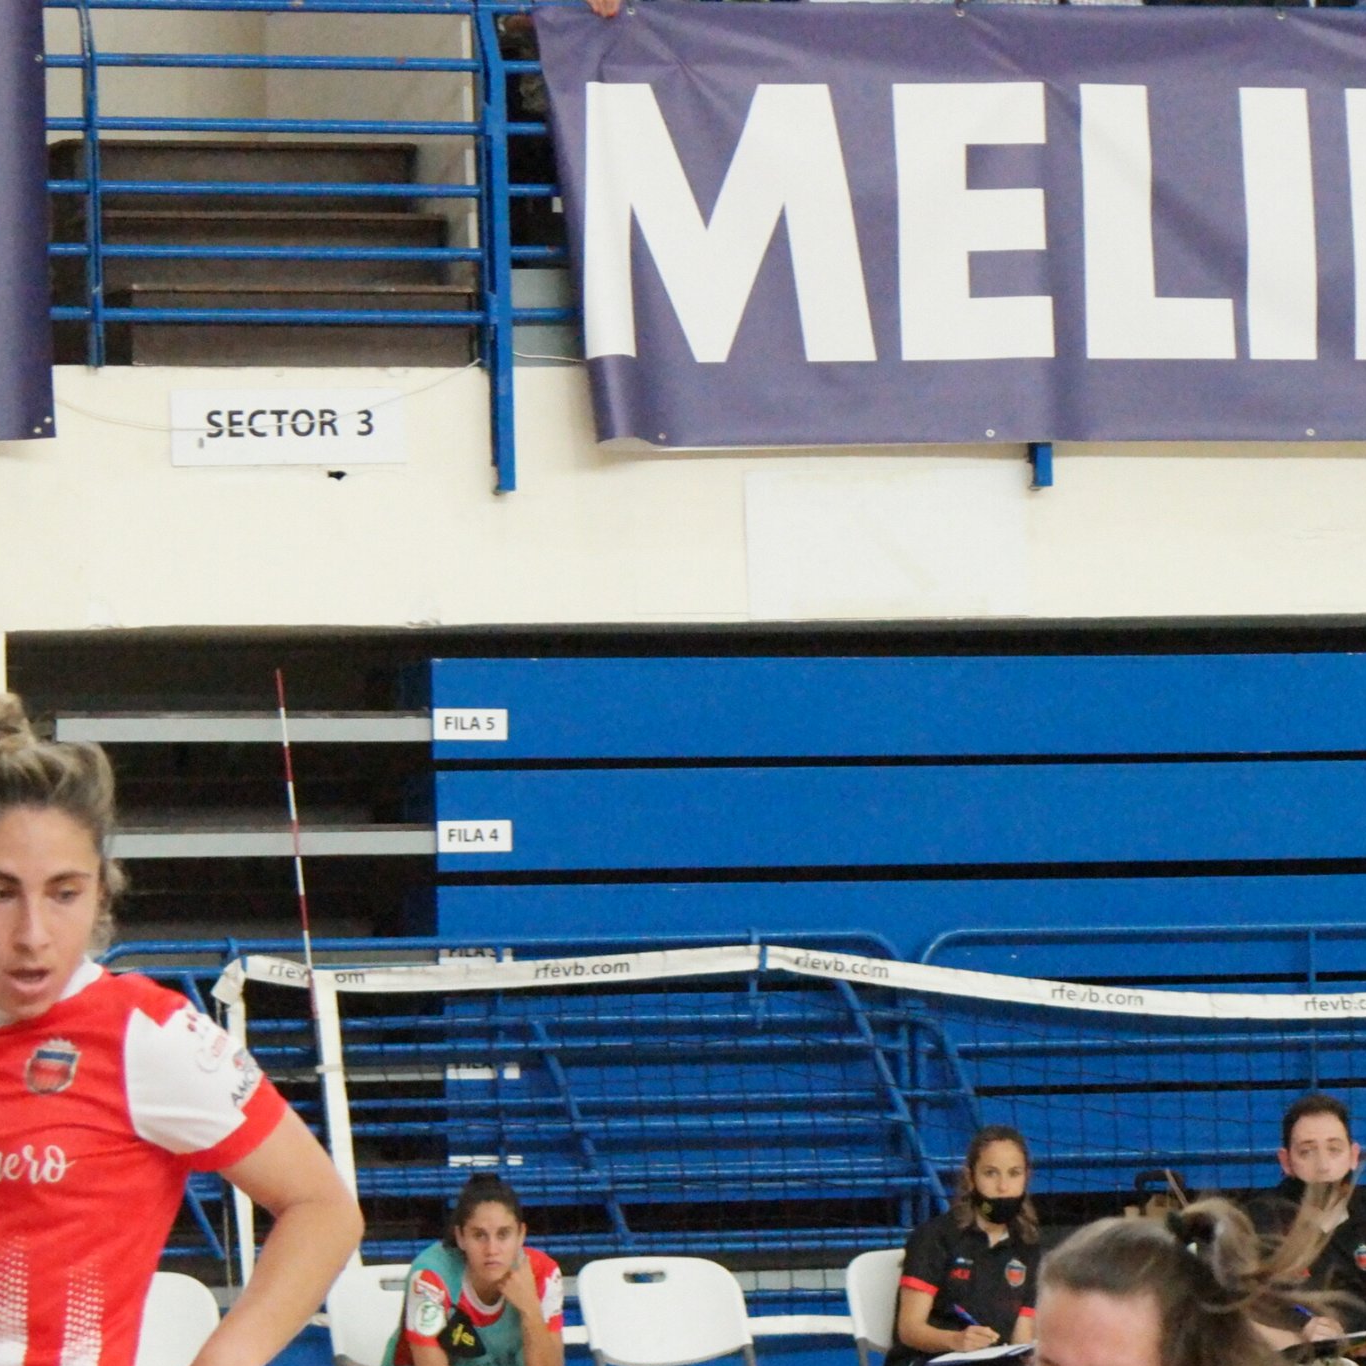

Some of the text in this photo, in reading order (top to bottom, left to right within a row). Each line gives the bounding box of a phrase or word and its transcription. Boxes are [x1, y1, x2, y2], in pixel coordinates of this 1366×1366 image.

[206, 409, 373, 438] SECTOR 3
[444, 716, 495, 731] FILA 5
[448, 828, 498, 843] FILA 4
[534, 960, 631, 979] rfevb.com
